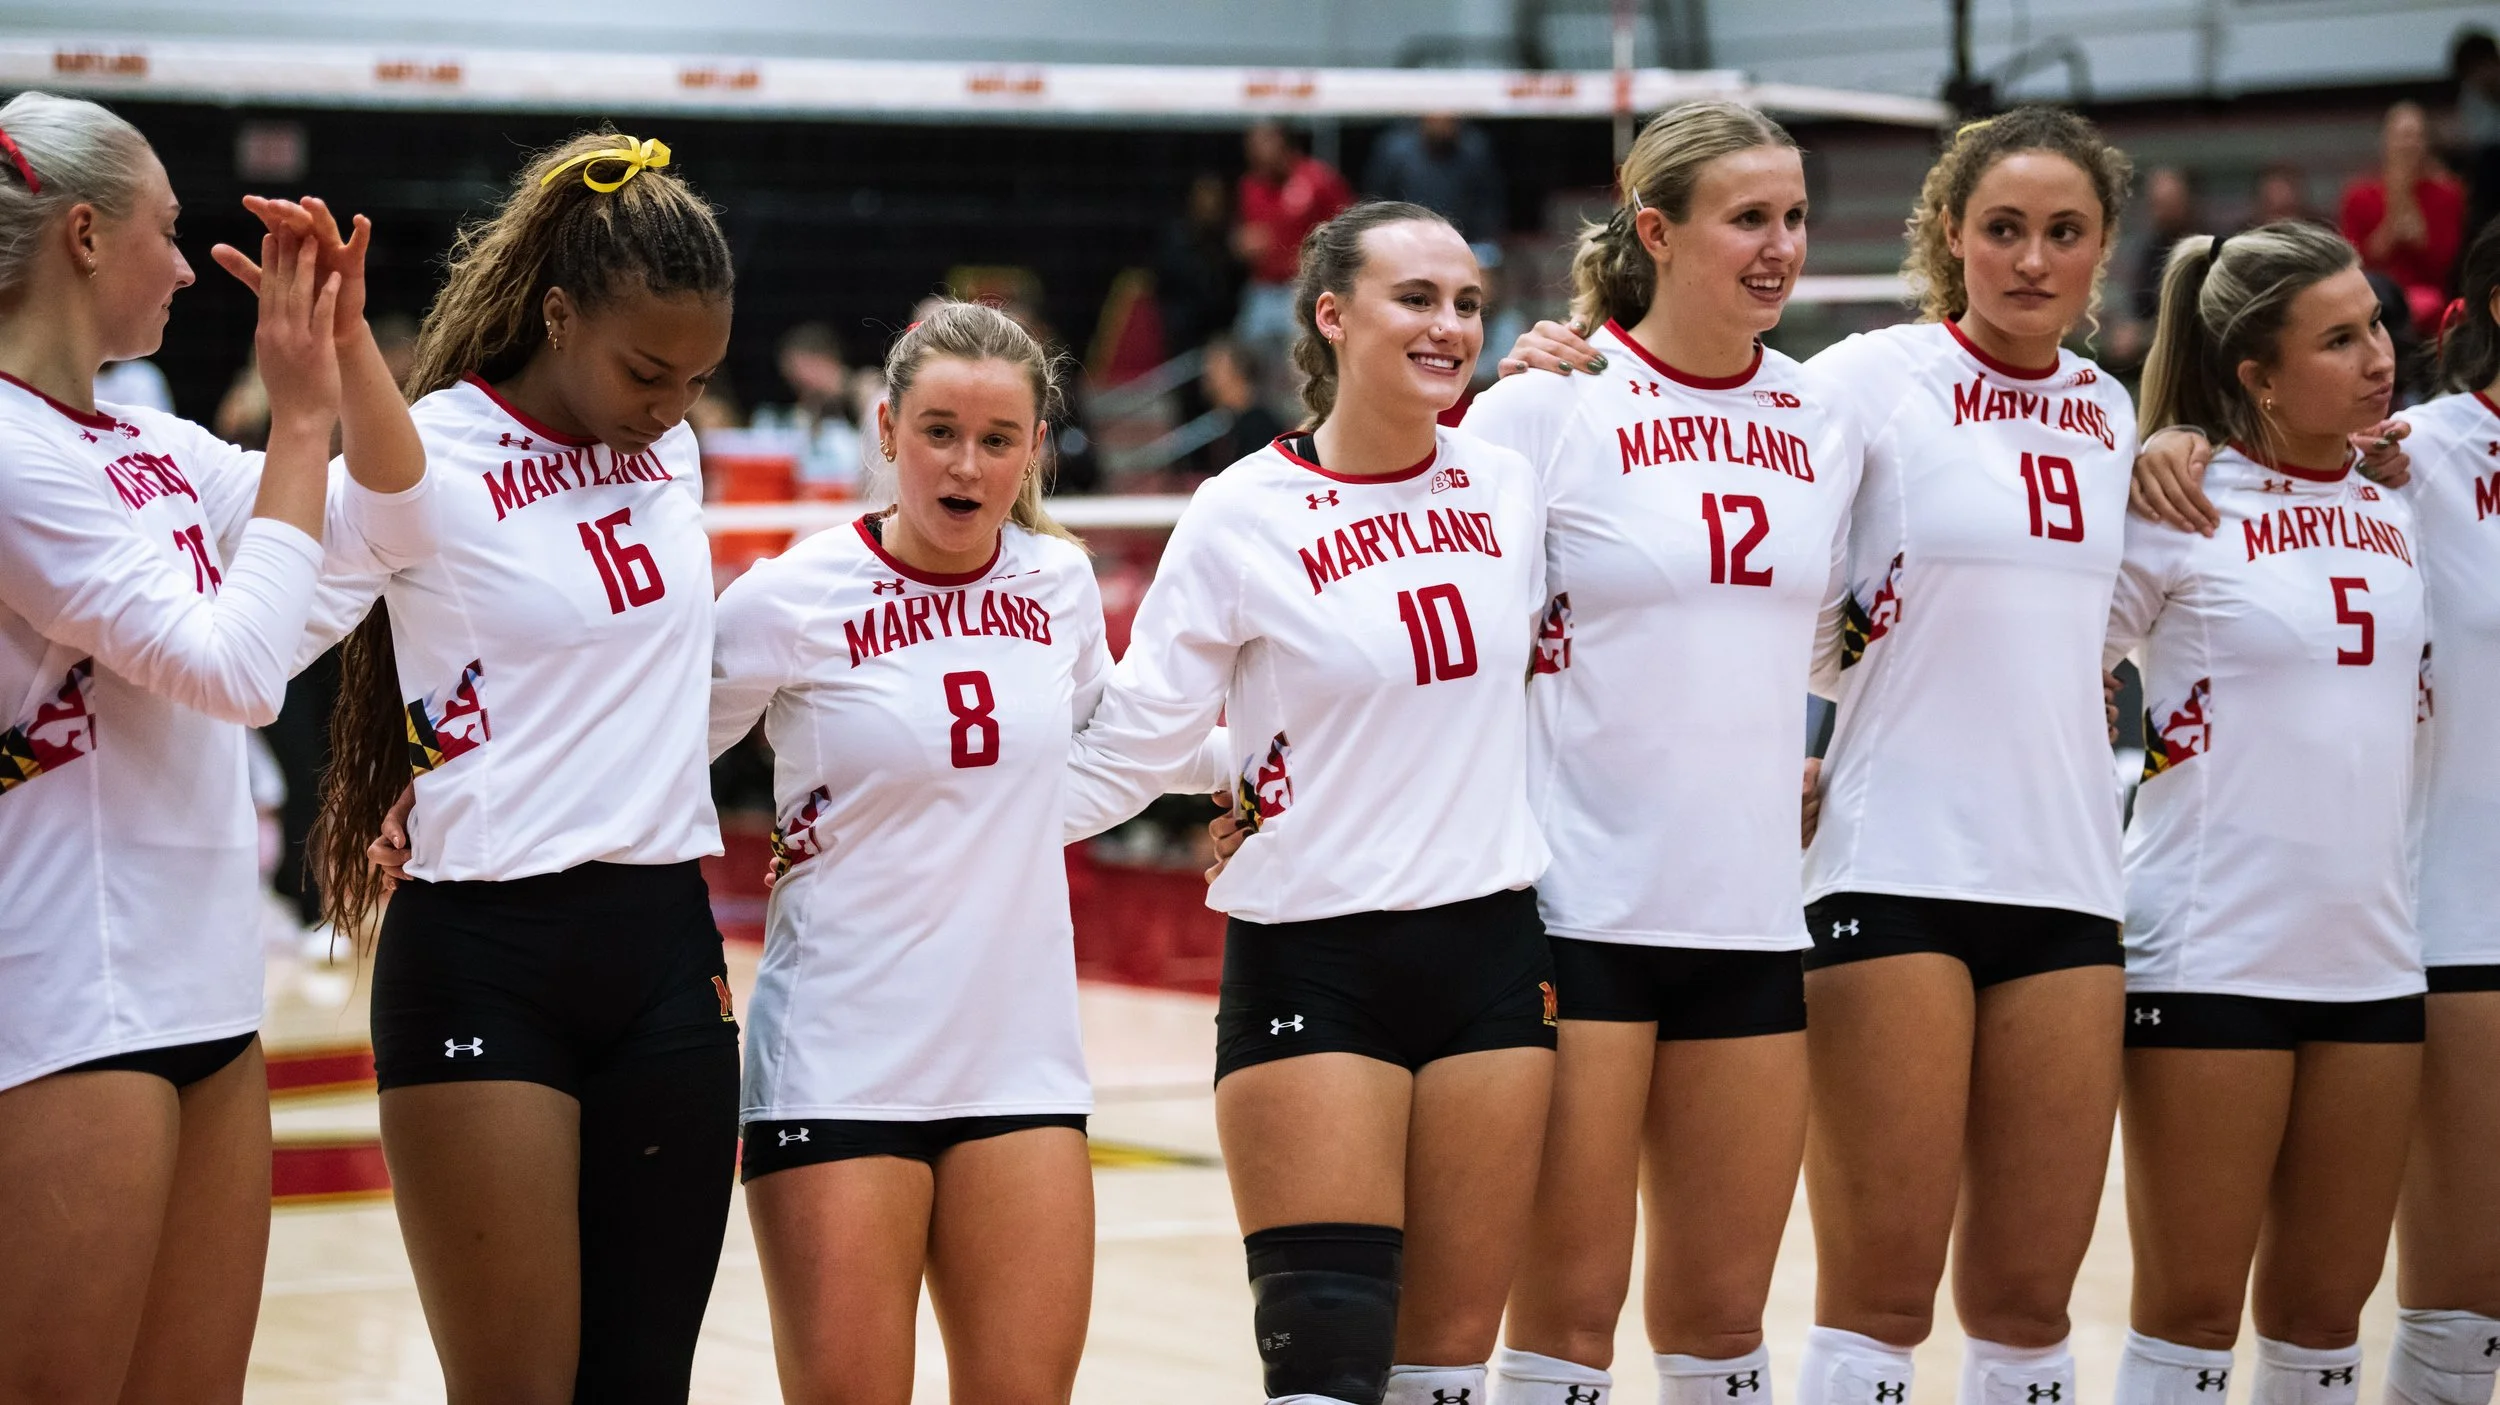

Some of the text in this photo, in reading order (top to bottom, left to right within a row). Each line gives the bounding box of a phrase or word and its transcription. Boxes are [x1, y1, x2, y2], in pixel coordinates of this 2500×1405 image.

[1616, 416, 1815, 483] MARYLAND
[1702, 492, 1773, 587] 12
[2020, 452, 2084, 543] 19
[2242, 506, 2413, 568] MARYLAND
[577, 507, 665, 615] 16
[1298, 508, 1502, 596] MARYLAND
[843, 590, 1052, 669] MARYLAND
[1397, 583, 1478, 686] 10
[2329, 577, 2374, 665] 5
[943, 671, 1000, 768] 8
